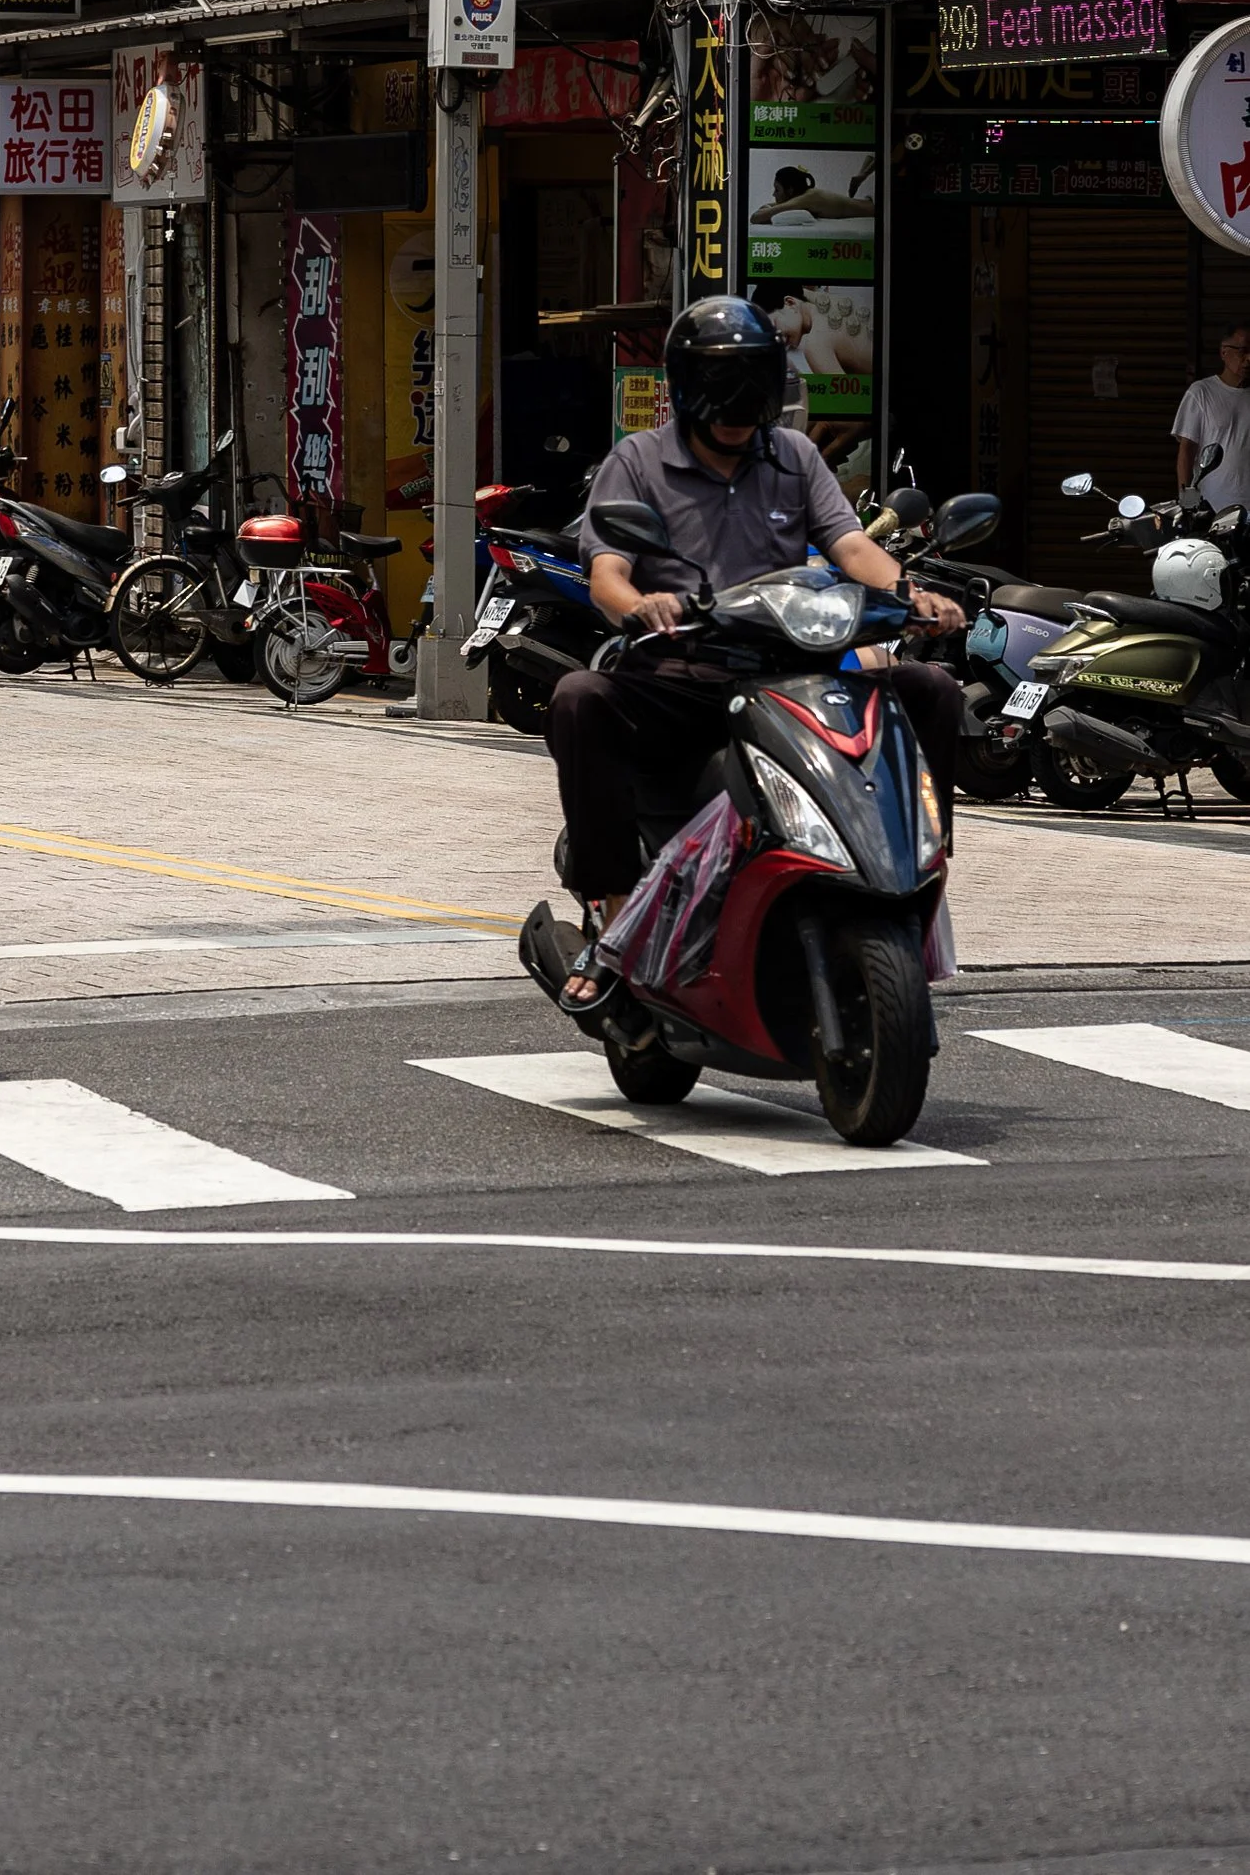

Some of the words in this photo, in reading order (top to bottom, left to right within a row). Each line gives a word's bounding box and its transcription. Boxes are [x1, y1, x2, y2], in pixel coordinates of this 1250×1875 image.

[10, 85, 95, 134] 松田
[833, 106, 864, 125] 500
[4, 137, 105, 185] 旅行箱
[692, 21, 724, 279] 大滿足
[1070, 175, 1146, 191] 0902-196812
[831, 242, 862, 260] 500
[300, 255, 329, 494] 刮刮樂
[830, 377, 861, 395] 500
[54, 324, 74, 498] 桂林米粉
[1021, 624, 1050, 638] JEGO
